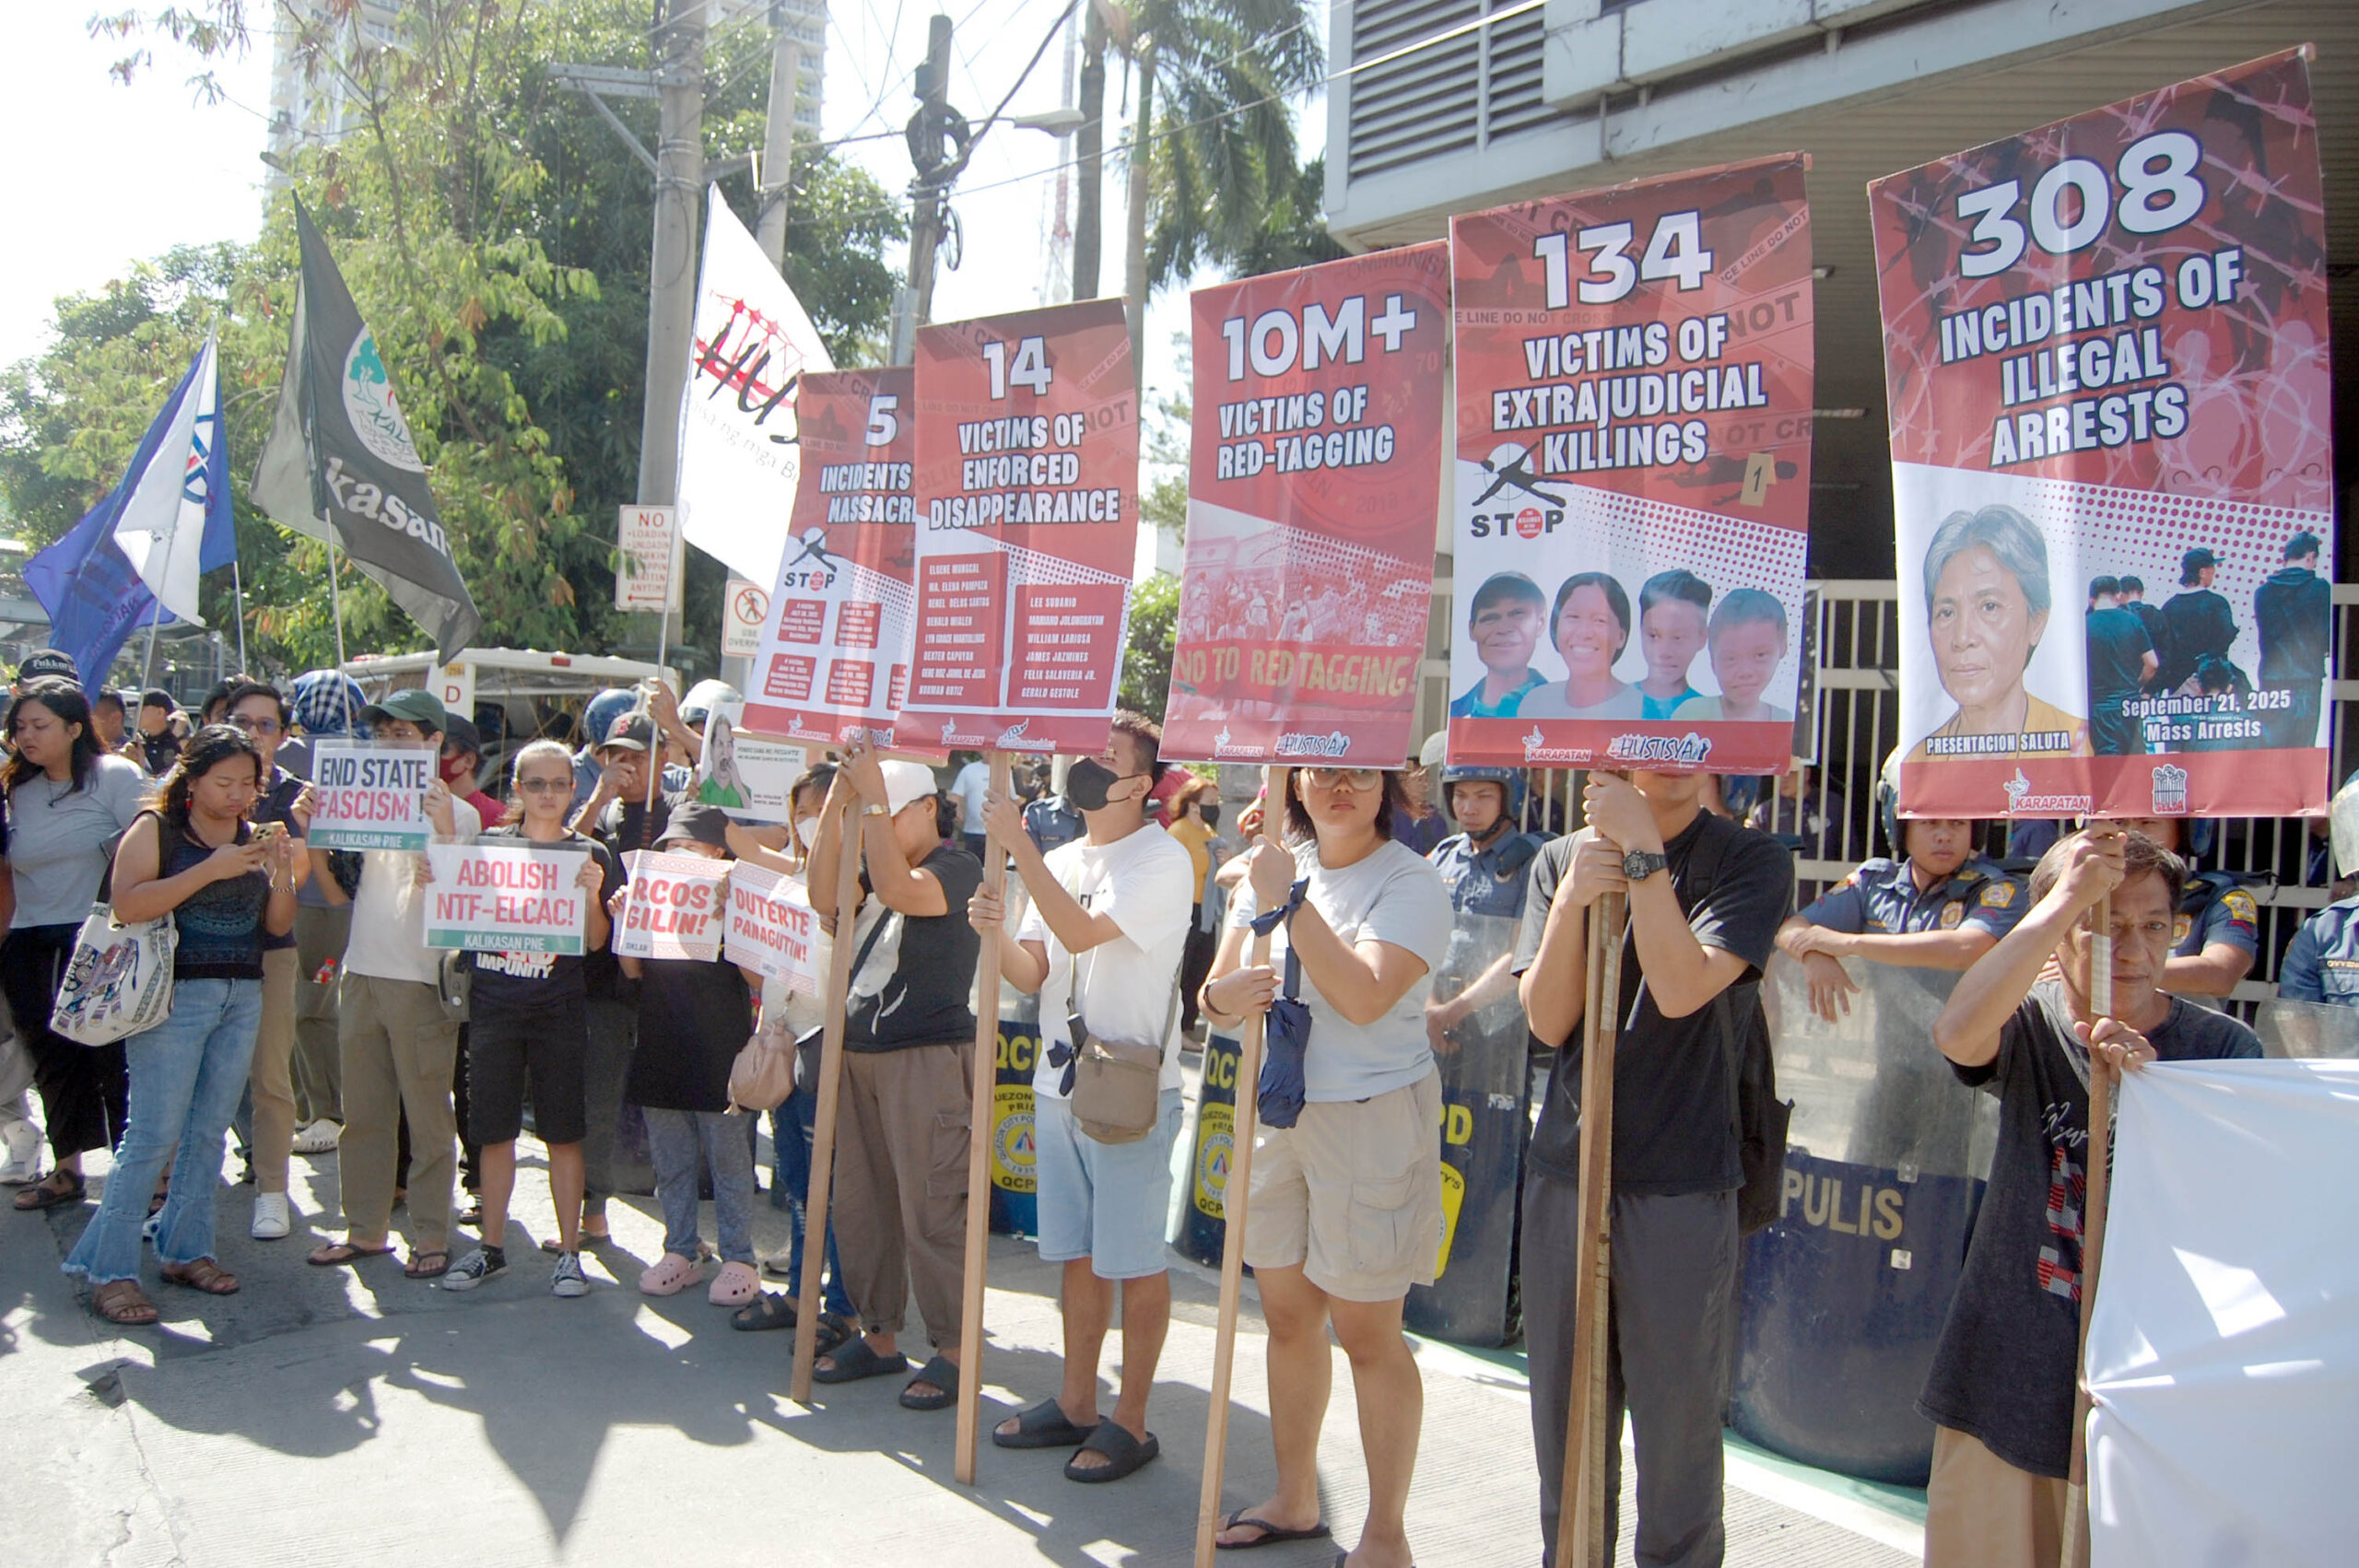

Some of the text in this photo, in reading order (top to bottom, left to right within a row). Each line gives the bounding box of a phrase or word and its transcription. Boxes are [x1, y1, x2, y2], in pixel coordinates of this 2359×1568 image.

[1956, 128, 2207, 278] 308
[1533, 207, 1714, 310] 134
[1940, 245, 2243, 365] INCIDENTS OF
[1222, 294, 1416, 382] 10M+
[1522, 313, 1729, 380] VICTIMS OF
[982, 335, 1052, 400] 14
[2001, 325, 2170, 406] ILLEGAL
[1219, 385, 1368, 439] VICTIMS OF
[1492, 362, 1768, 430] EXTRAJUDICIAL
[865, 395, 898, 446] 5
[958, 413, 1085, 454] VICTIMS OF
[1990, 383, 2189, 468] ARRESTS
[1217, 424, 1395, 479] RED-TAGGING
[1542, 420, 1708, 474] KILLINGS
[820, 462, 912, 493] INCIDENTS
[962, 451, 1079, 491] ENFORCED
[1754, 465, 1762, 492] 1
[639, 512, 664, 527] NO
[827, 495, 915, 523] MASSACR
[929, 487, 1121, 530] DISAPPEARANCE
[632, 530, 669, 538] LOADIN
[1176, 649, 1206, 684] NO
[1213, 646, 1240, 683] TO
[1250, 649, 1294, 687] RED
[445, 685, 461, 703] D
[2122, 690, 2291, 719] September 21, 2025
[1926, 731, 2070, 755] PRESENTACION SALUTA
[2146, 719, 2261, 743] Mass Arrests
[1530, 748, 1590, 761] KARAPATAN
[1620, 738, 1694, 758] HUSTISYA
[320, 757, 427, 789] END STATE
[316, 790, 411, 822] FASCISM
[2014, 797, 2089, 811] KARAPATAN
[329, 833, 403, 848] KALIKASAN PNE
[457, 859, 557, 891] ABOLISH
[437, 893, 574, 926] NTF-ELCAC!
[735, 887, 810, 937] DUTERTE
[464, 934, 545, 951] KALIKASAN PNE
[734, 916, 807, 964] PANAGUTIN!
[476, 953, 554, 978] IMPUNITY
[995, 1093, 1032, 1102] UEZON
[1002, 1176, 1037, 1188] QCP
[1779, 1168, 1903, 1240] PULIS
